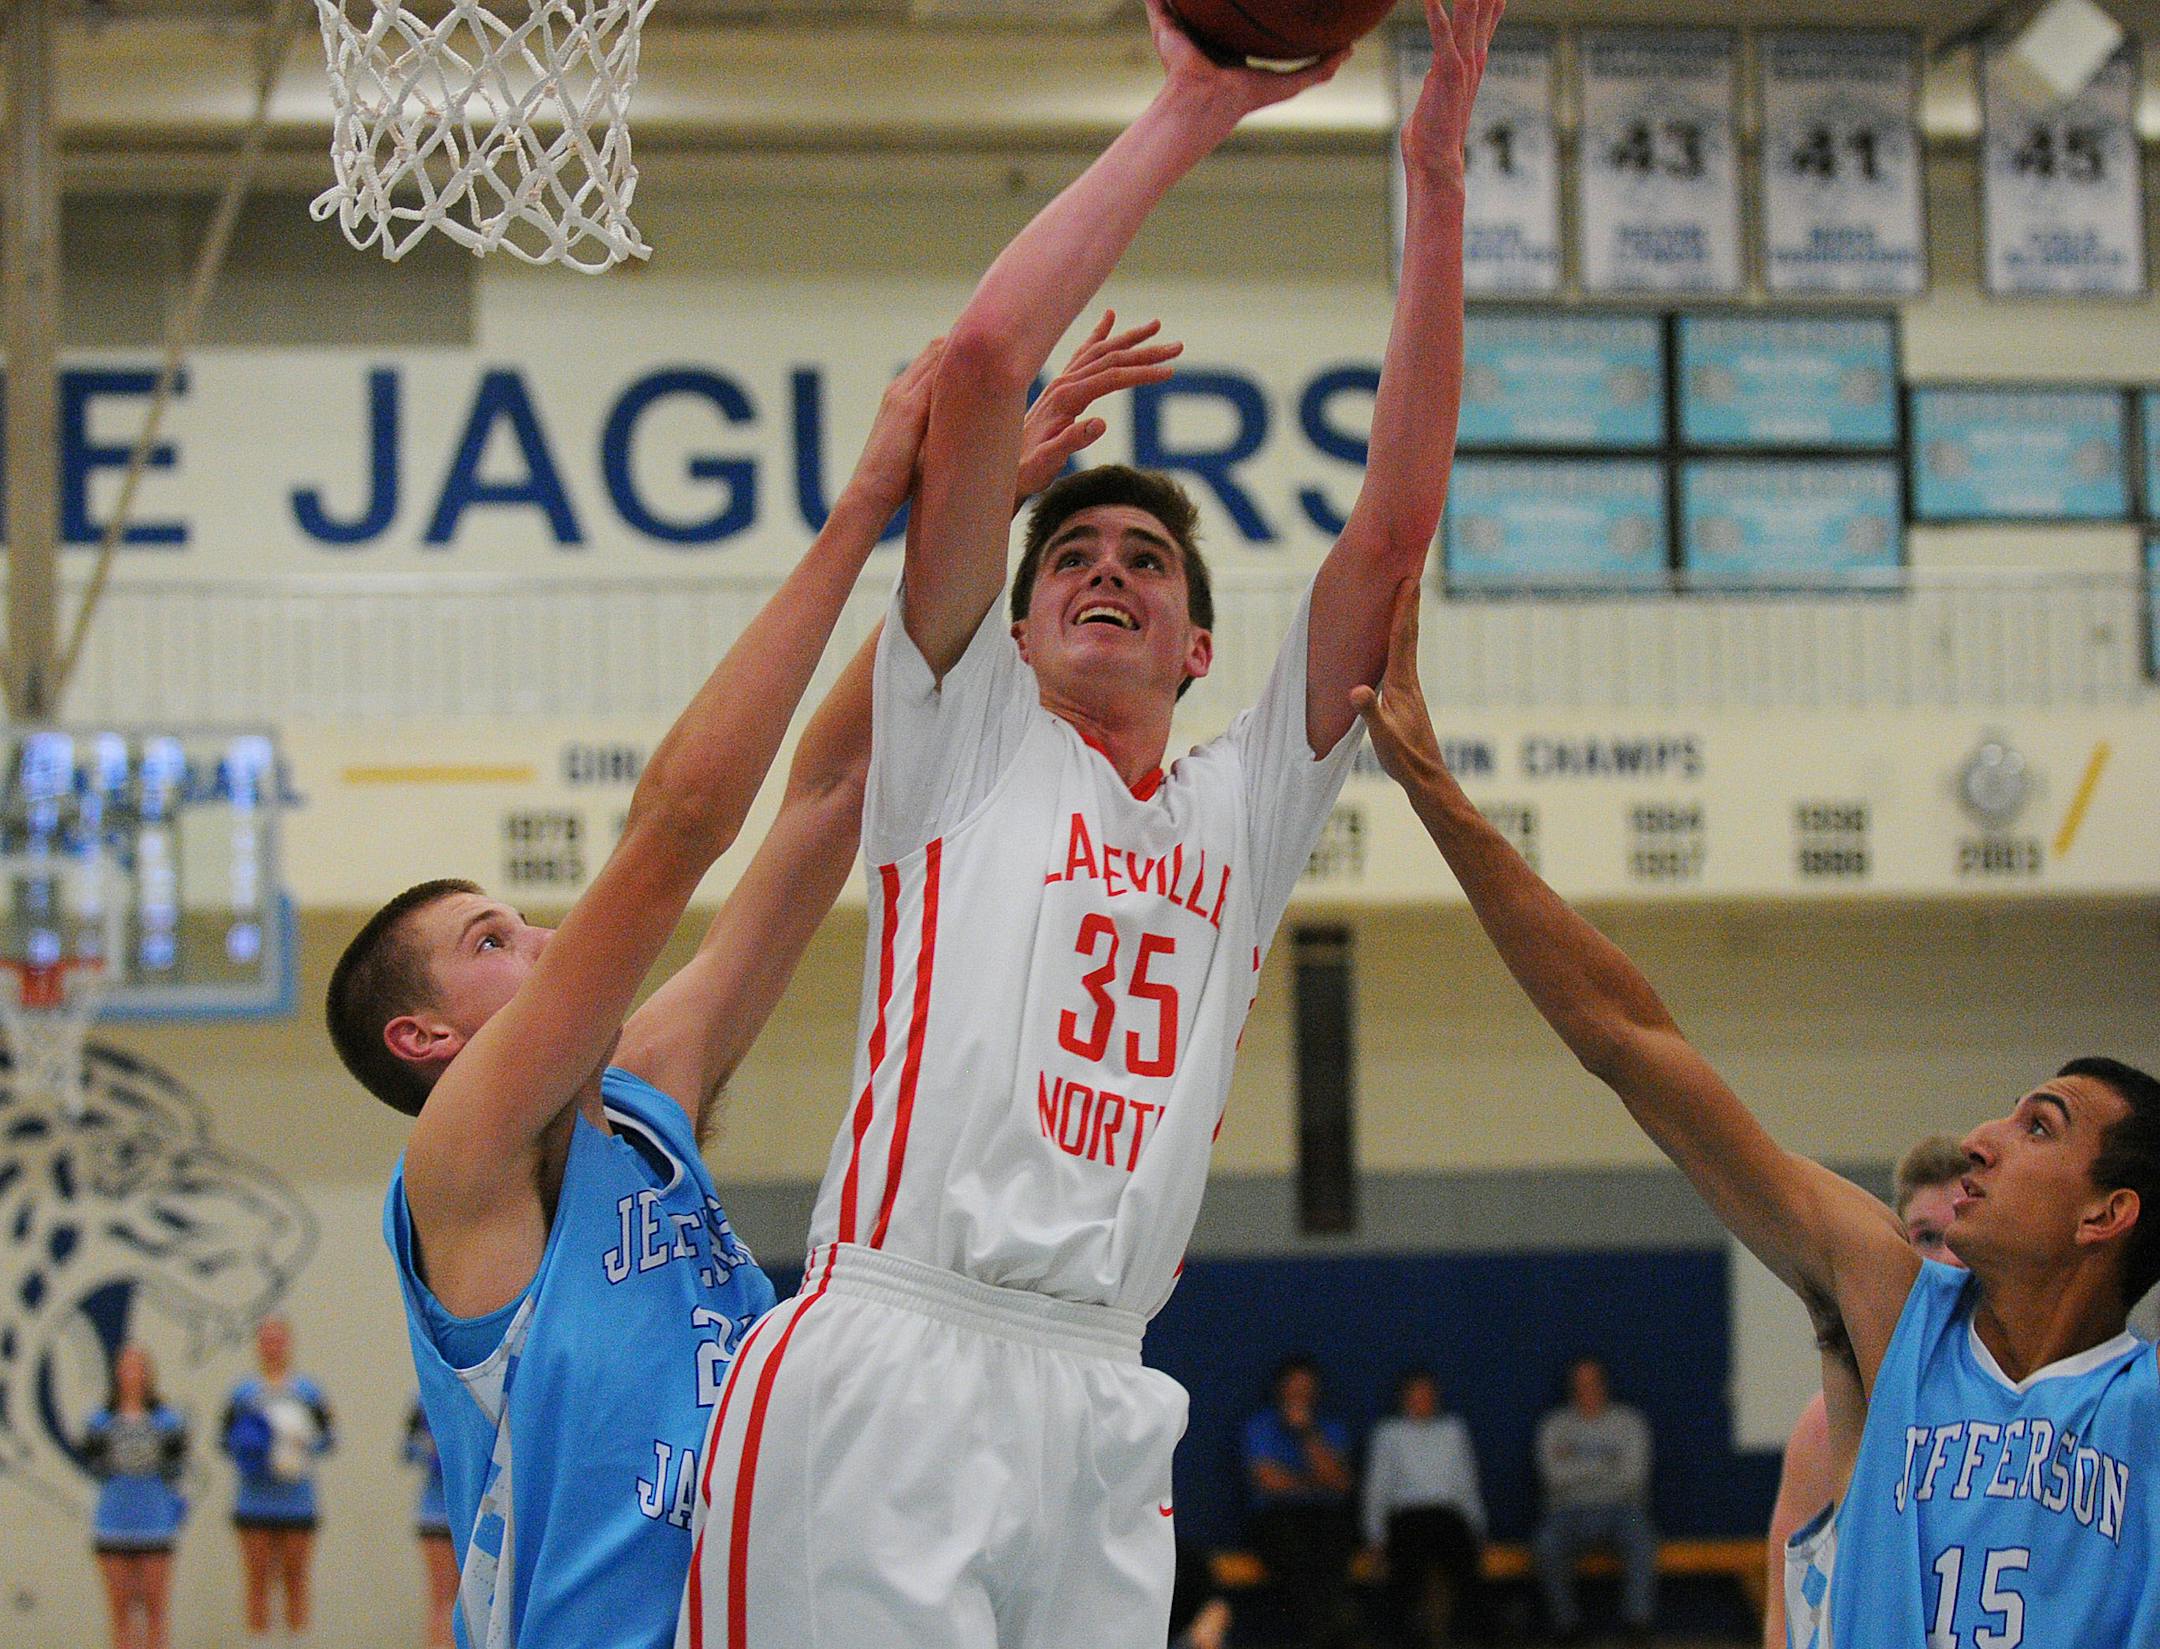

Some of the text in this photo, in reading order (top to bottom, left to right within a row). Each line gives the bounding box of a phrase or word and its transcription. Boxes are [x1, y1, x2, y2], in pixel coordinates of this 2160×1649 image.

[1608, 117, 1705, 181] 43
[1791, 121, 1881, 182] 41
[0, 366, 1390, 547] E JAGURS
[1519, 738, 1704, 778] CHAMPS
[1058, 912, 1179, 1078] 35
[1038, 1070, 1166, 1173] NORT
[1926, 1545, 2031, 1649] 15
